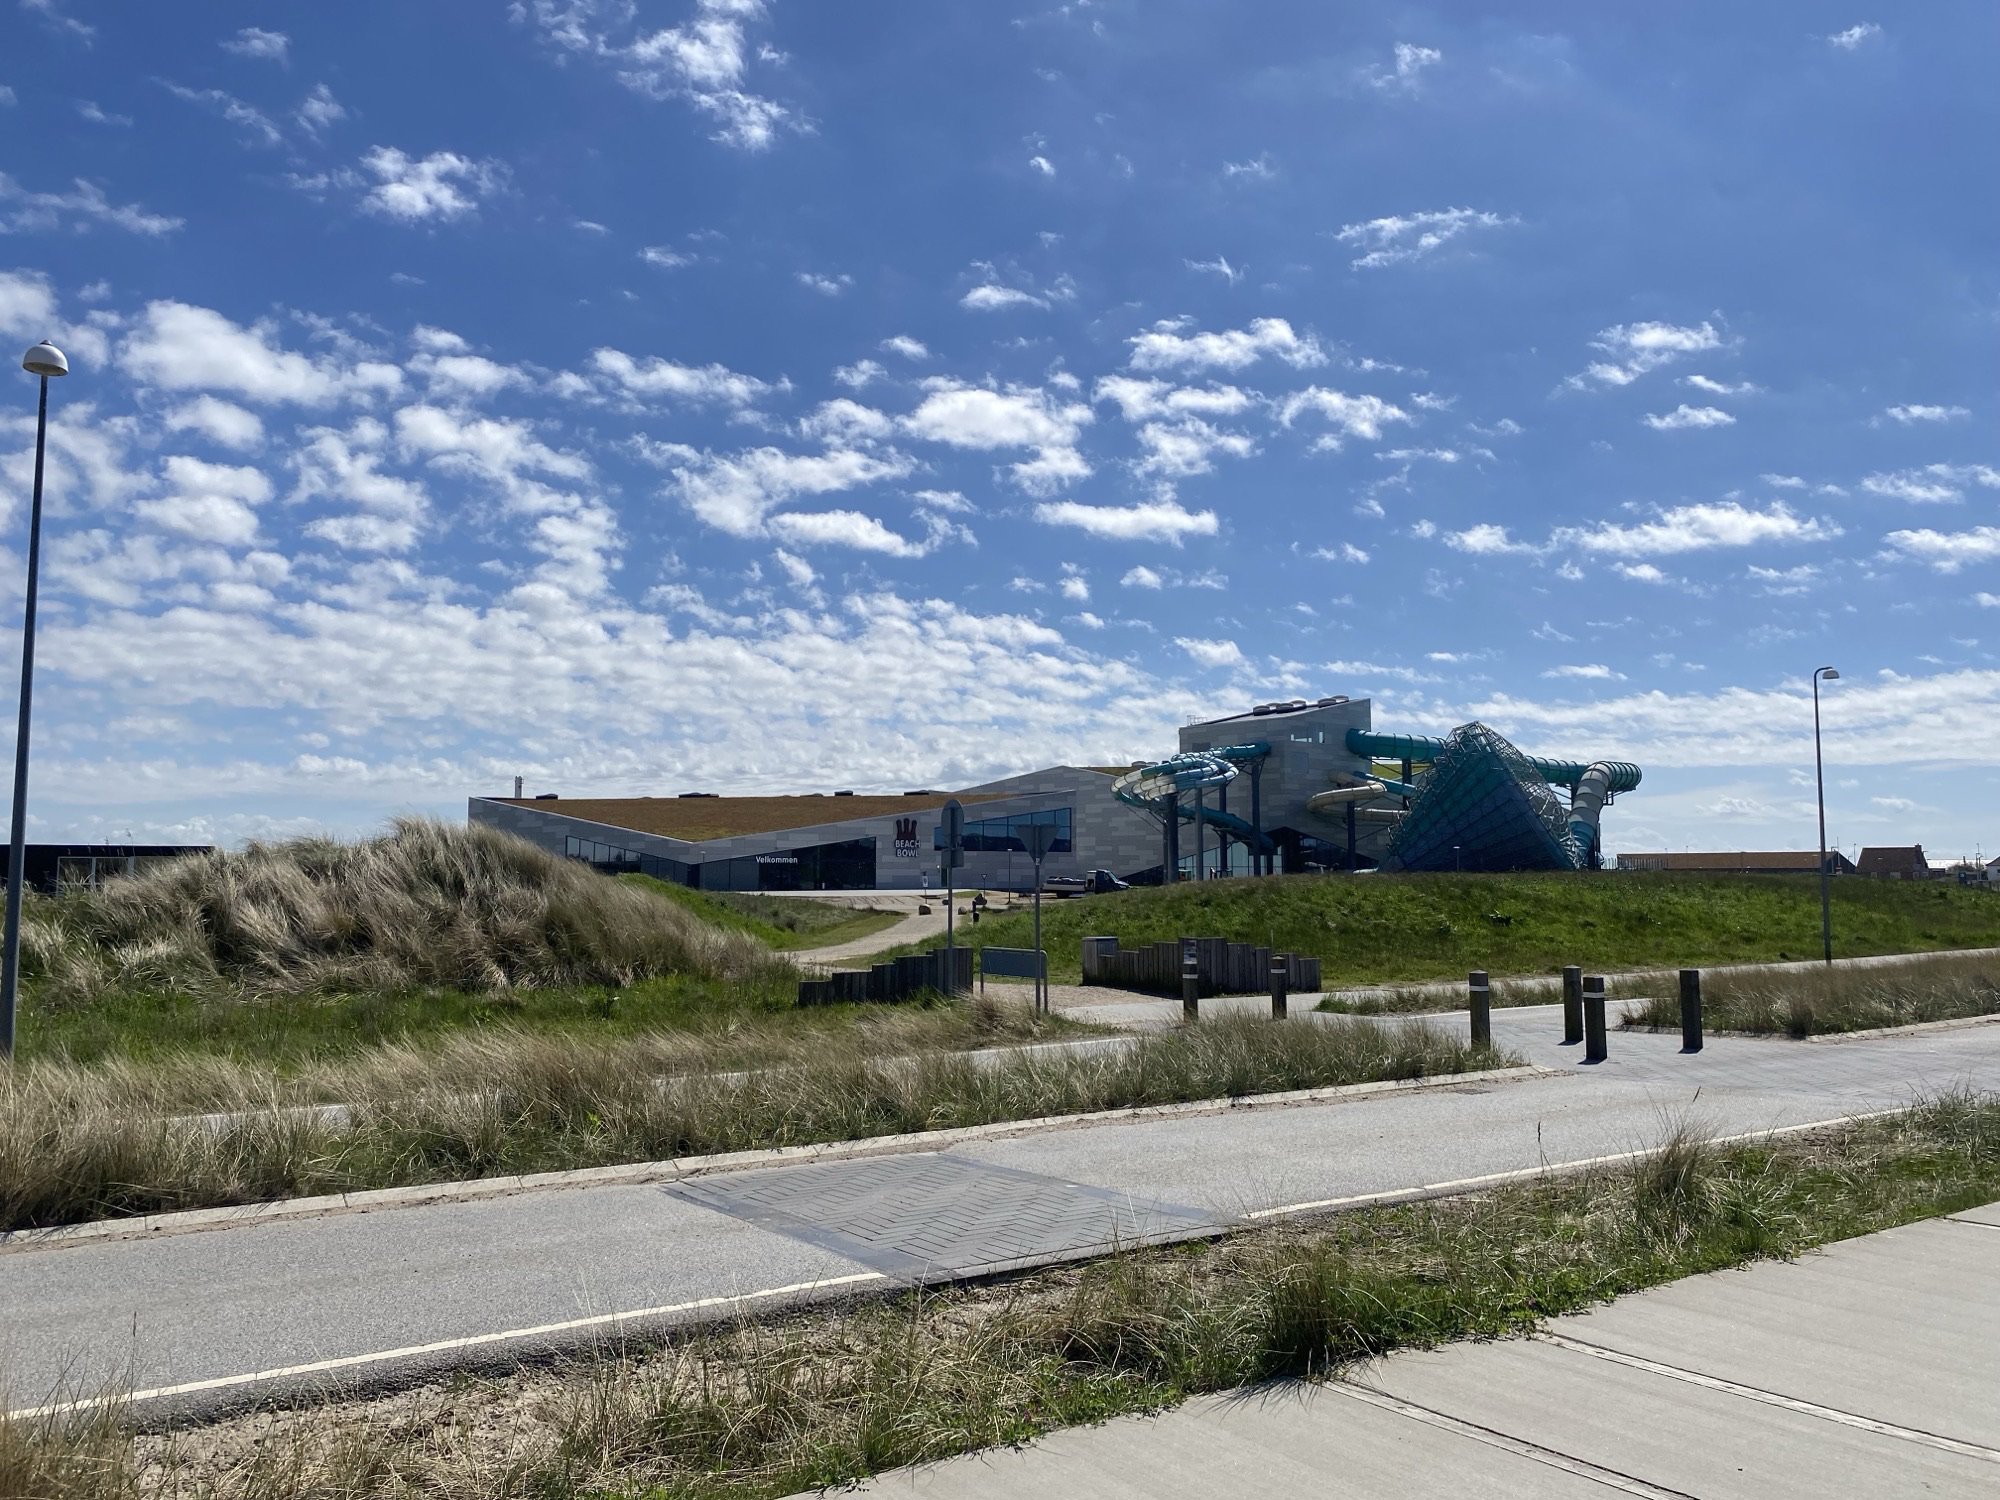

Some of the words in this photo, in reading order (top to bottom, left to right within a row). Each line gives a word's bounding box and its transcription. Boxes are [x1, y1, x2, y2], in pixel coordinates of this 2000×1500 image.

[895, 839, 920, 848] BEACH
[896, 849, 919, 857] BOWL
[755, 855, 798, 864] Velkommen
